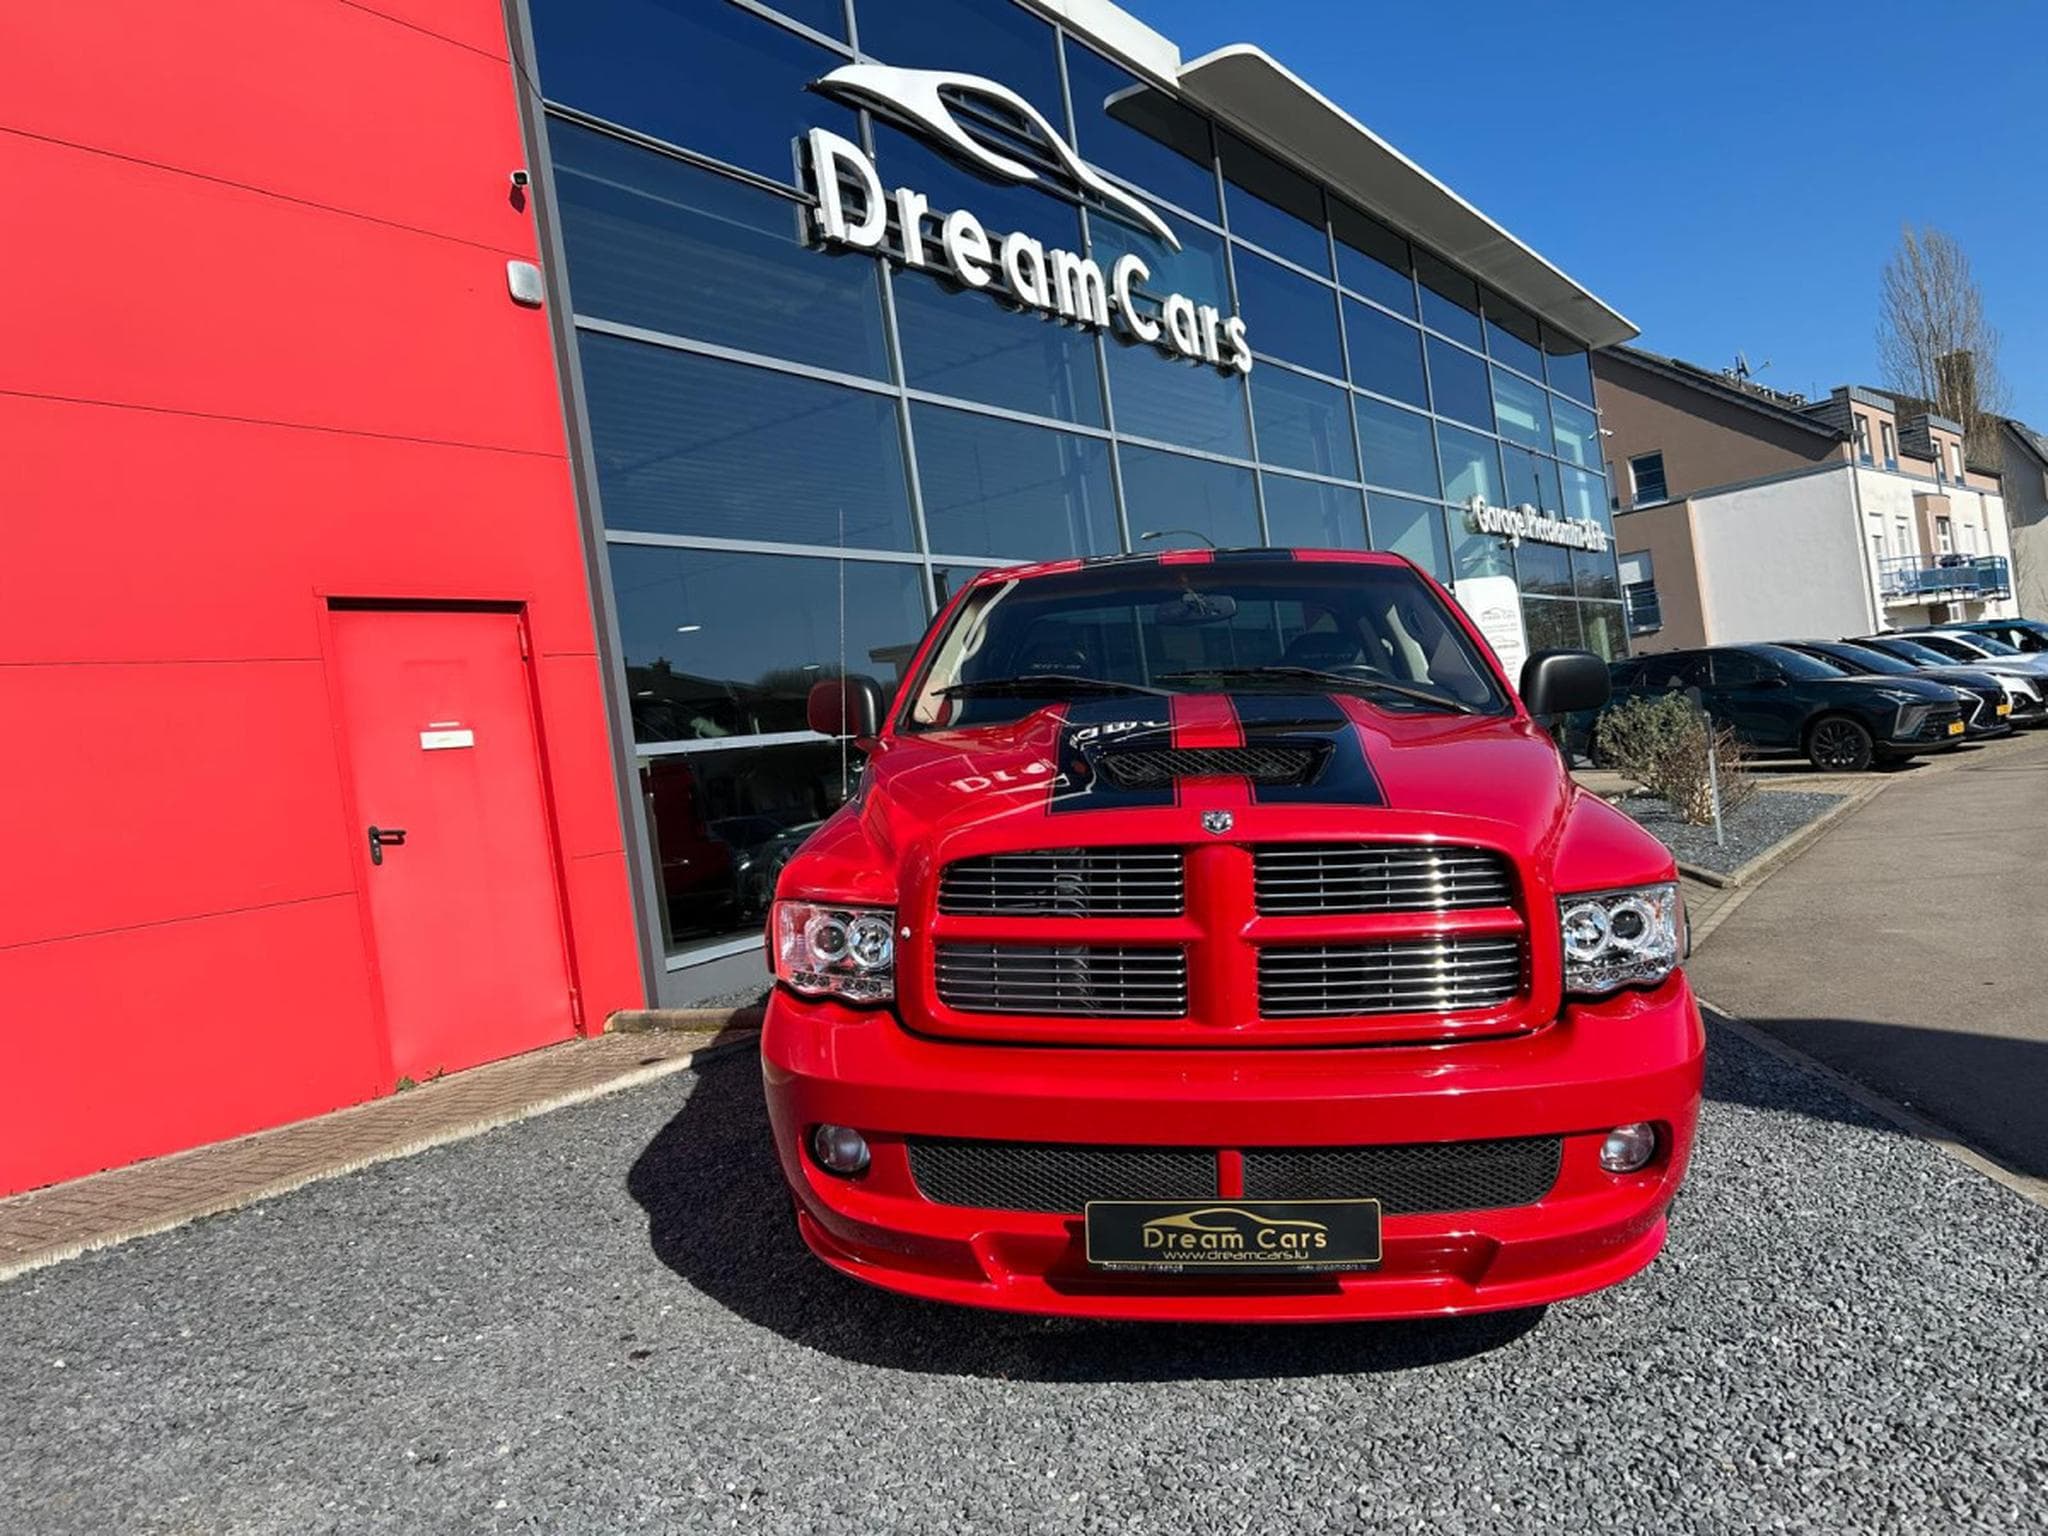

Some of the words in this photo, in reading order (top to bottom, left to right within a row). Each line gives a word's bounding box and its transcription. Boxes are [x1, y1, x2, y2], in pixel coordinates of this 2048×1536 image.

[1473, 494, 1526, 548] Garage
[1143, 1228, 1244, 1249] Dream
[1256, 1228, 1328, 1249] Cars
[1162, 1250, 1309, 1261] www.dreamcars.lu
